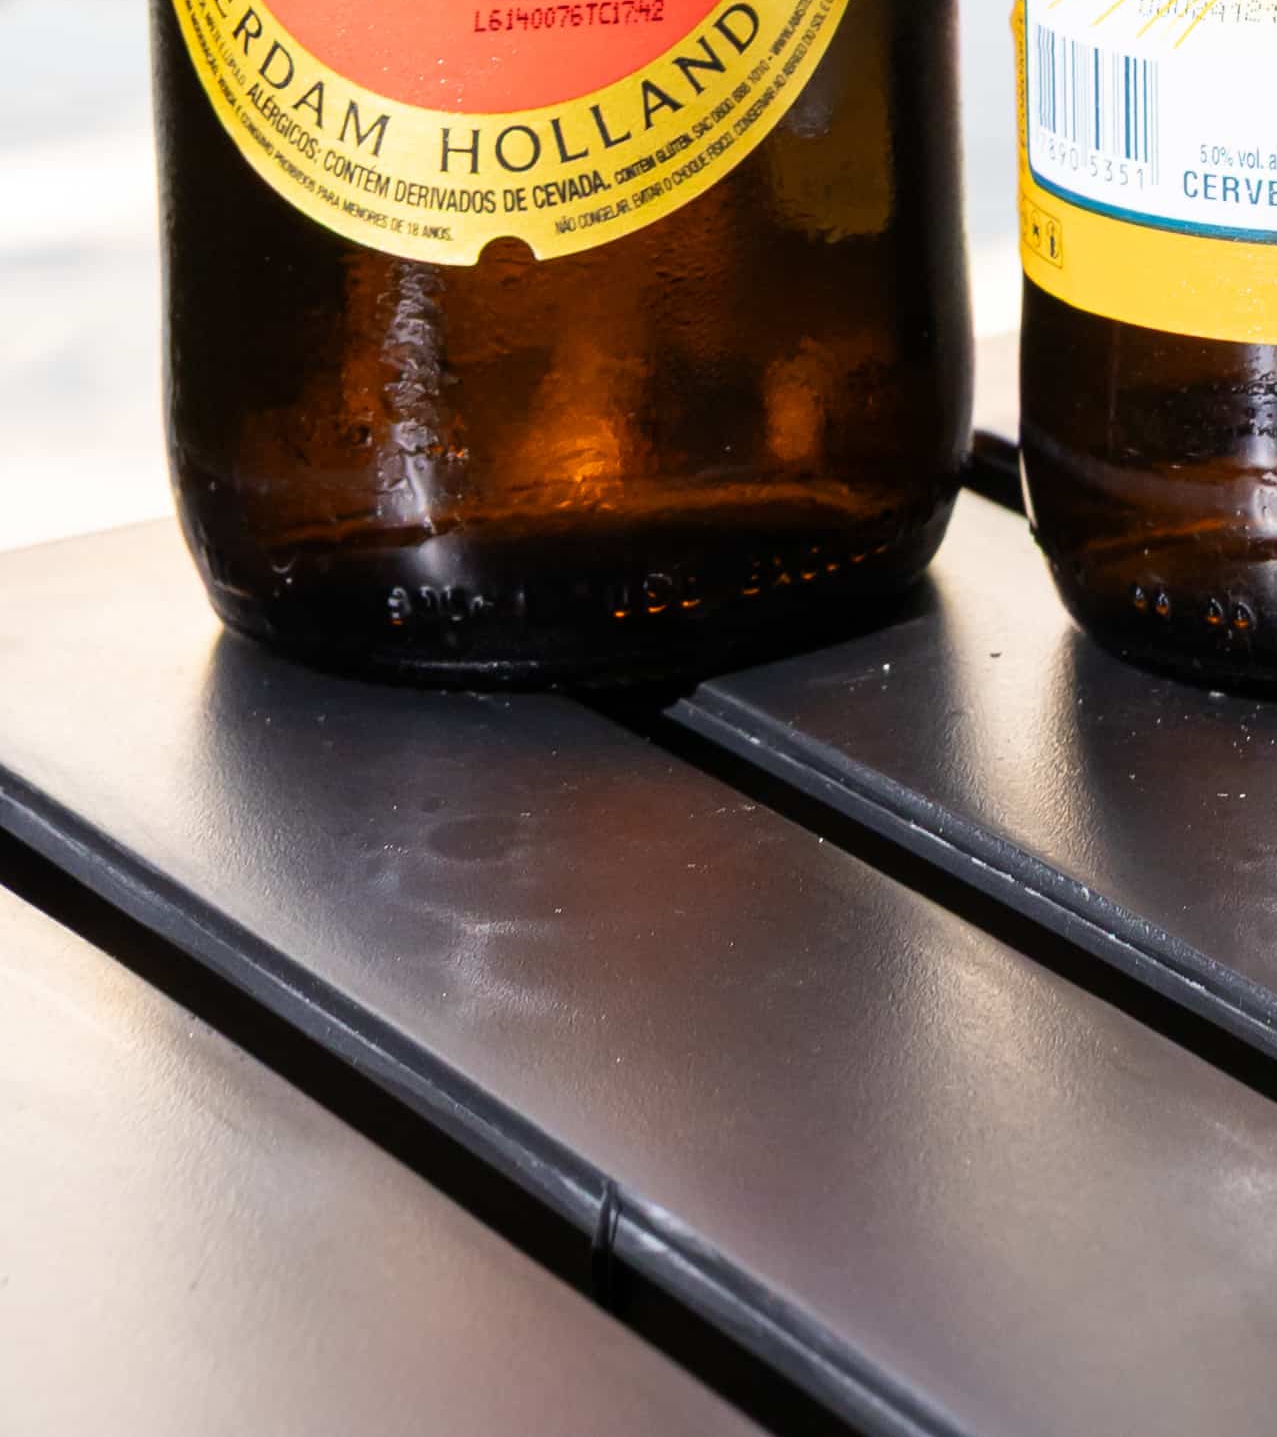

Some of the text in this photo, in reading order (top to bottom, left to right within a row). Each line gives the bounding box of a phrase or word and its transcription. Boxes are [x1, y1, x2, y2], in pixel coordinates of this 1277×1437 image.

[438, 2, 763, 176] HOLLAND
[246, 82, 321, 164] ALÉRGICOS:
[322, 149, 390, 202] CONTÉM
[394, 179, 497, 215] DERIVADOS
[503, 187, 529, 214] DE
[532, 169, 612, 210] CEVADA.
[1236, 145, 1264, 172] vol.
[315, 184, 342, 209] PARA
[339, 201, 390, 230] MENORES
[389, 219, 405, 234] DE
[406, 222, 420, 237] 18
